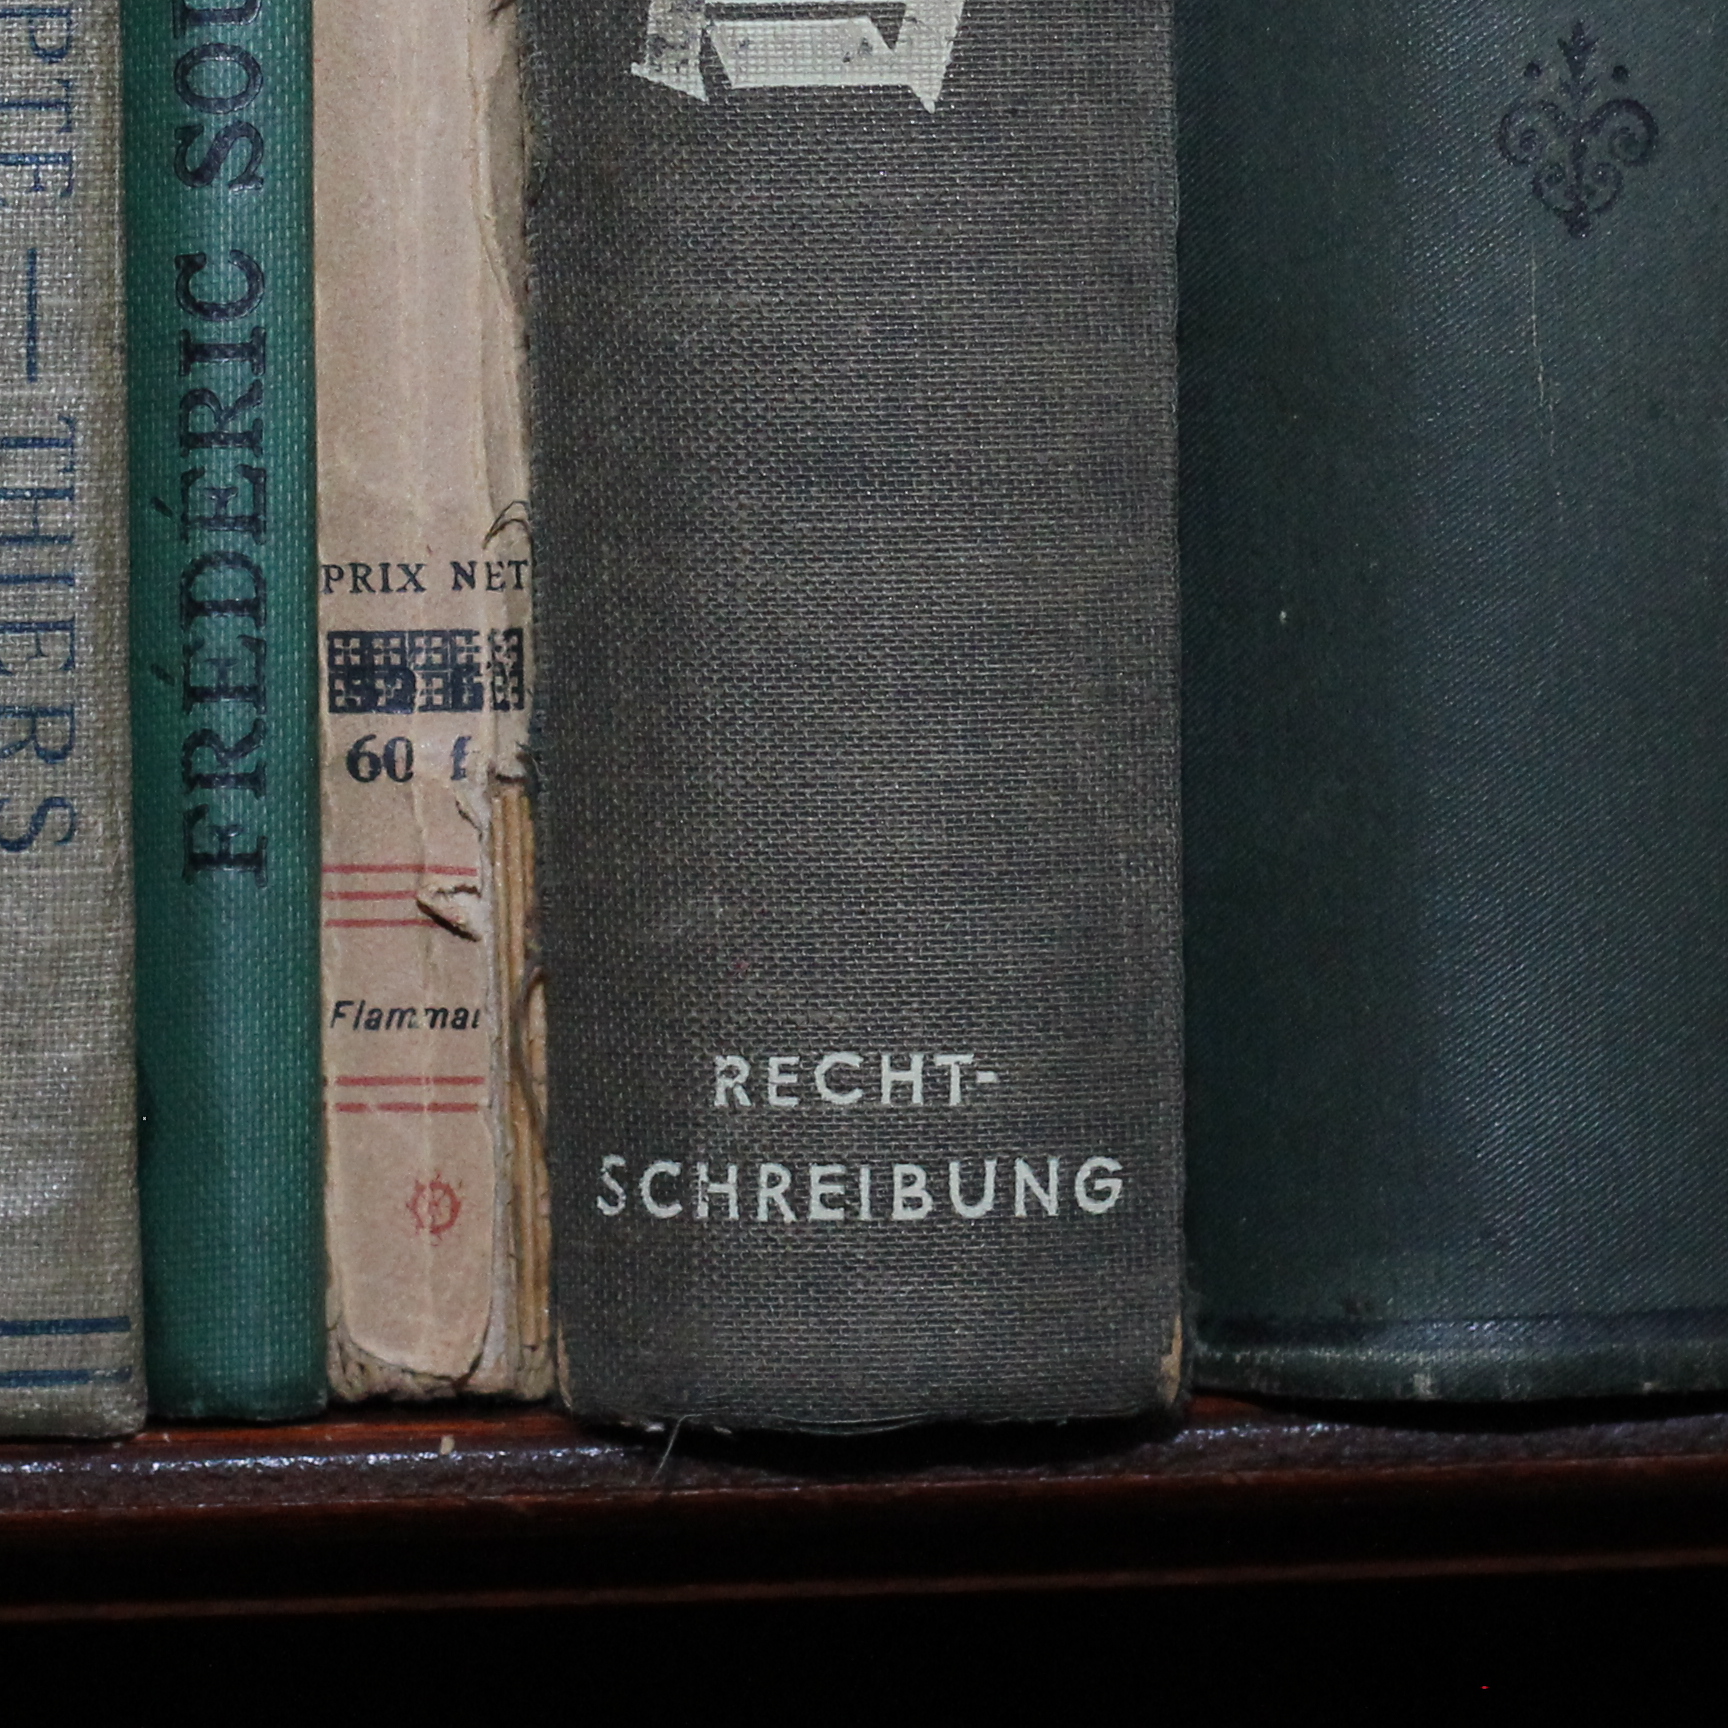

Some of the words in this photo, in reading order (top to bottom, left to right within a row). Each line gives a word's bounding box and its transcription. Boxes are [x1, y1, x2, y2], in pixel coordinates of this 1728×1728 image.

[149, 249, 269, 888] FRÉDÉRIC
[322, 562, 427, 594] PRIX
[450, 559, 528, 592] NET
[346, 734, 414, 783] 60
[713, 1052, 998, 1107] RECHT-
[597, 1154, 1123, 1223] SCHREIBUNG
